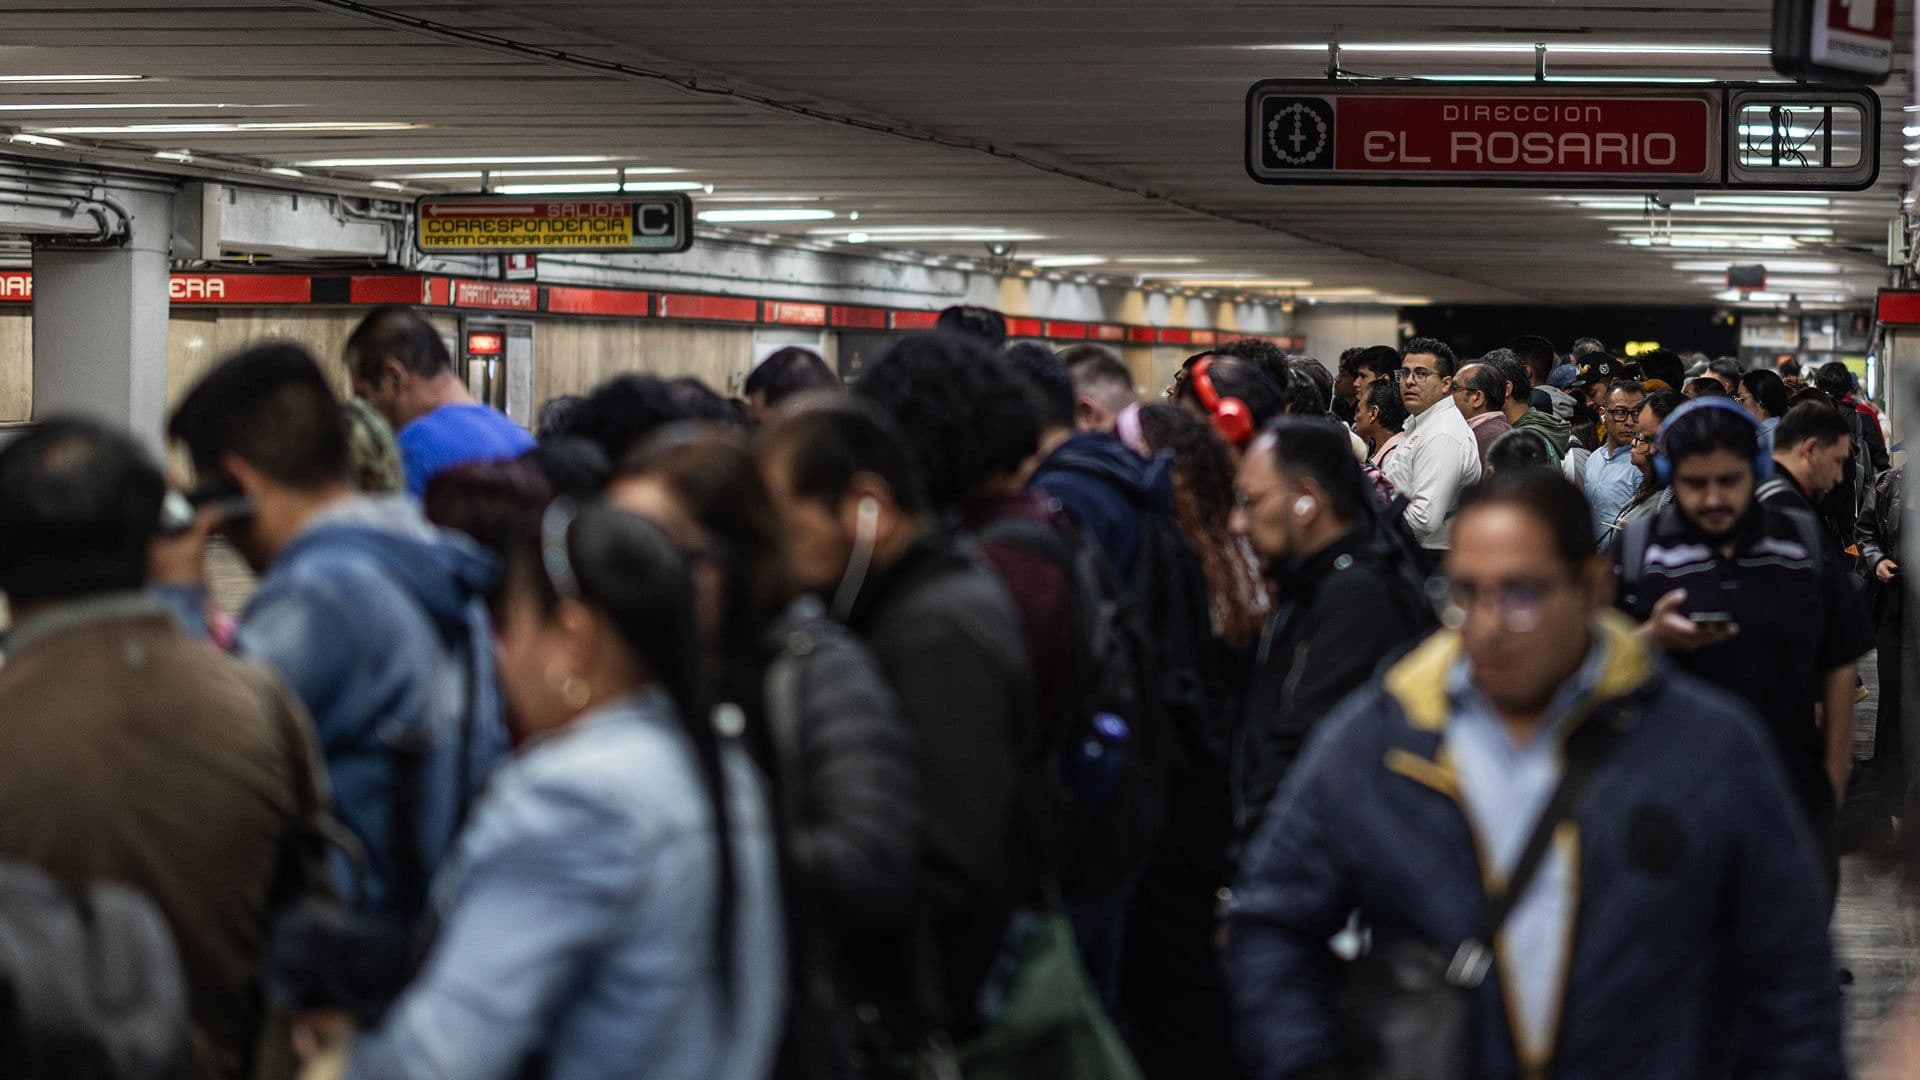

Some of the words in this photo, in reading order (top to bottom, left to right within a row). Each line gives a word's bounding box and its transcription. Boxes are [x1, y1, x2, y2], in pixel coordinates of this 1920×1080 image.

[1443, 105, 1601, 122] DIRECCION
[1363, 131, 1431, 163] EL
[1450, 132, 1676, 165] ROSARIO
[547, 203, 625, 217] SALIDA
[427, 219, 625, 233] CORRESPONDENCIA
[638, 204, 668, 235] C
[425, 234, 475, 246] MARTIN
[477, 234, 540, 246] CARRERA
